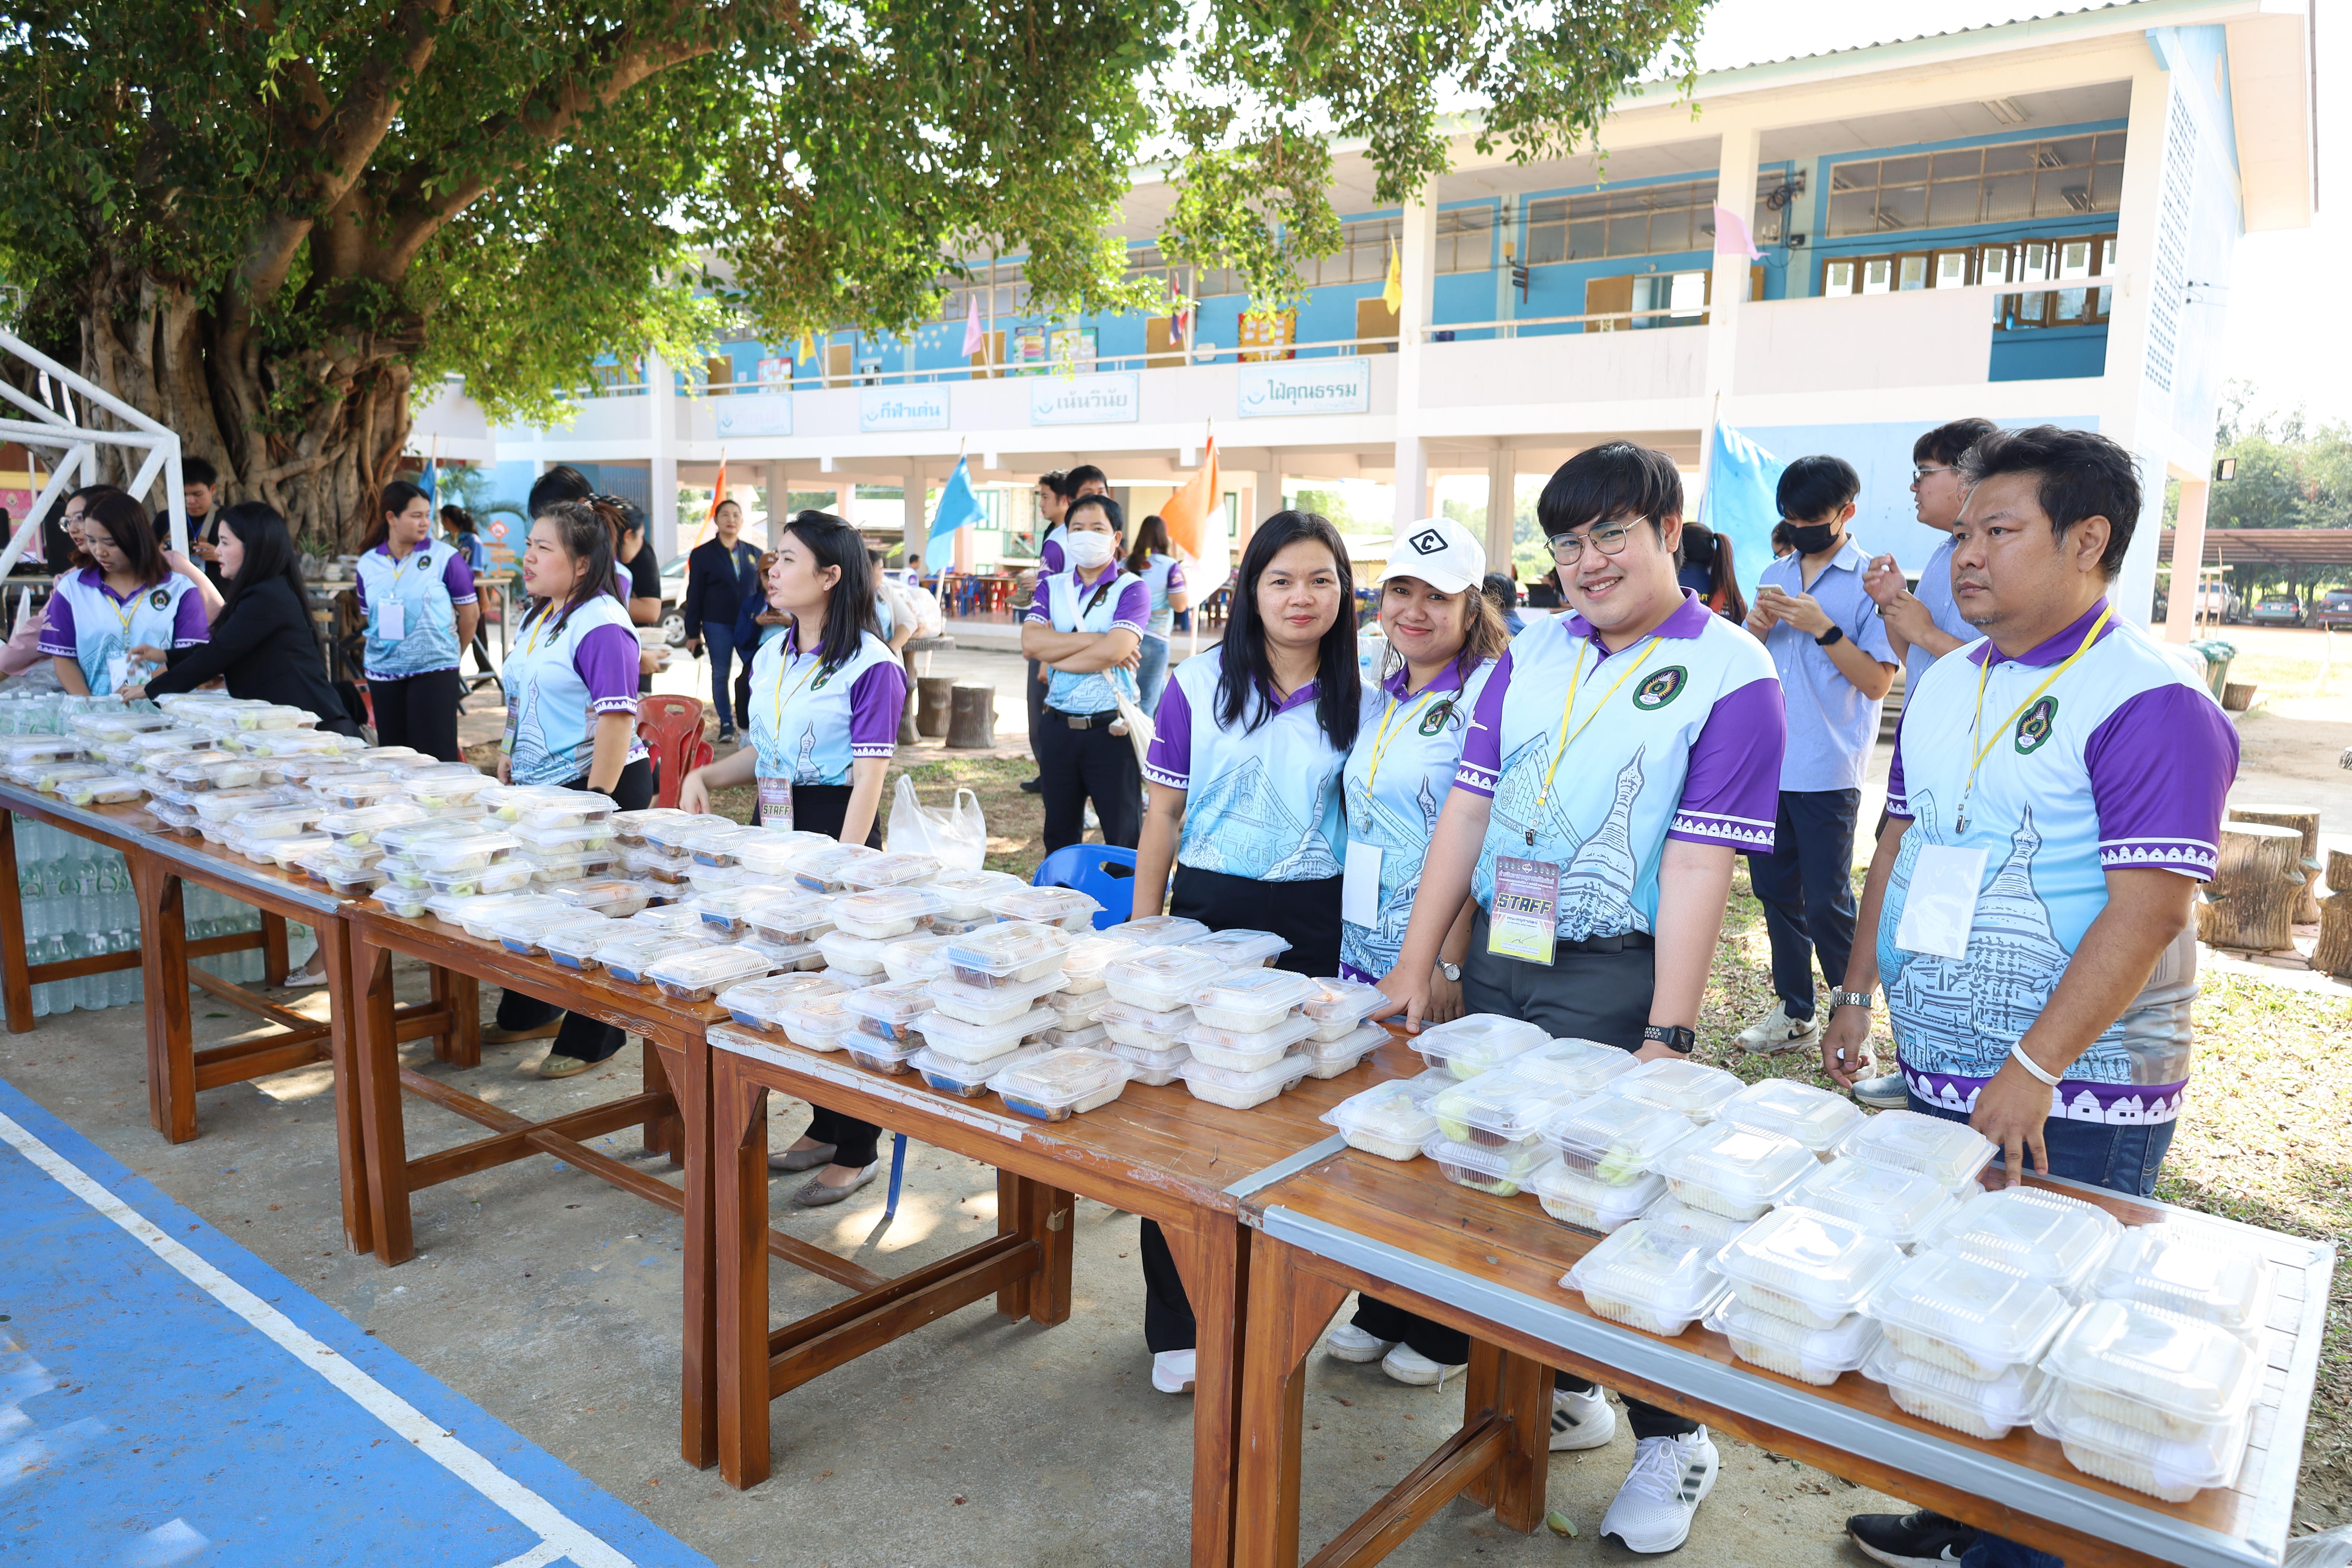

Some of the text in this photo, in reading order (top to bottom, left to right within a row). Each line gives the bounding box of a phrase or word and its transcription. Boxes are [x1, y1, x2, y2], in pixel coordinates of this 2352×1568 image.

[1057, 388, 1128, 409] เน้นวินัย
[1268, 379, 1357, 406] ใฝ่คุณธรรม
[880, 400, 941, 418] กีฬาเด่น
[1421, 535, 1434, 550] C
[763, 805, 790, 816] STAFF
[1497, 893, 1553, 915] STAFF
[1507, 916, 1538, 925] คณะครุศาสตร์
